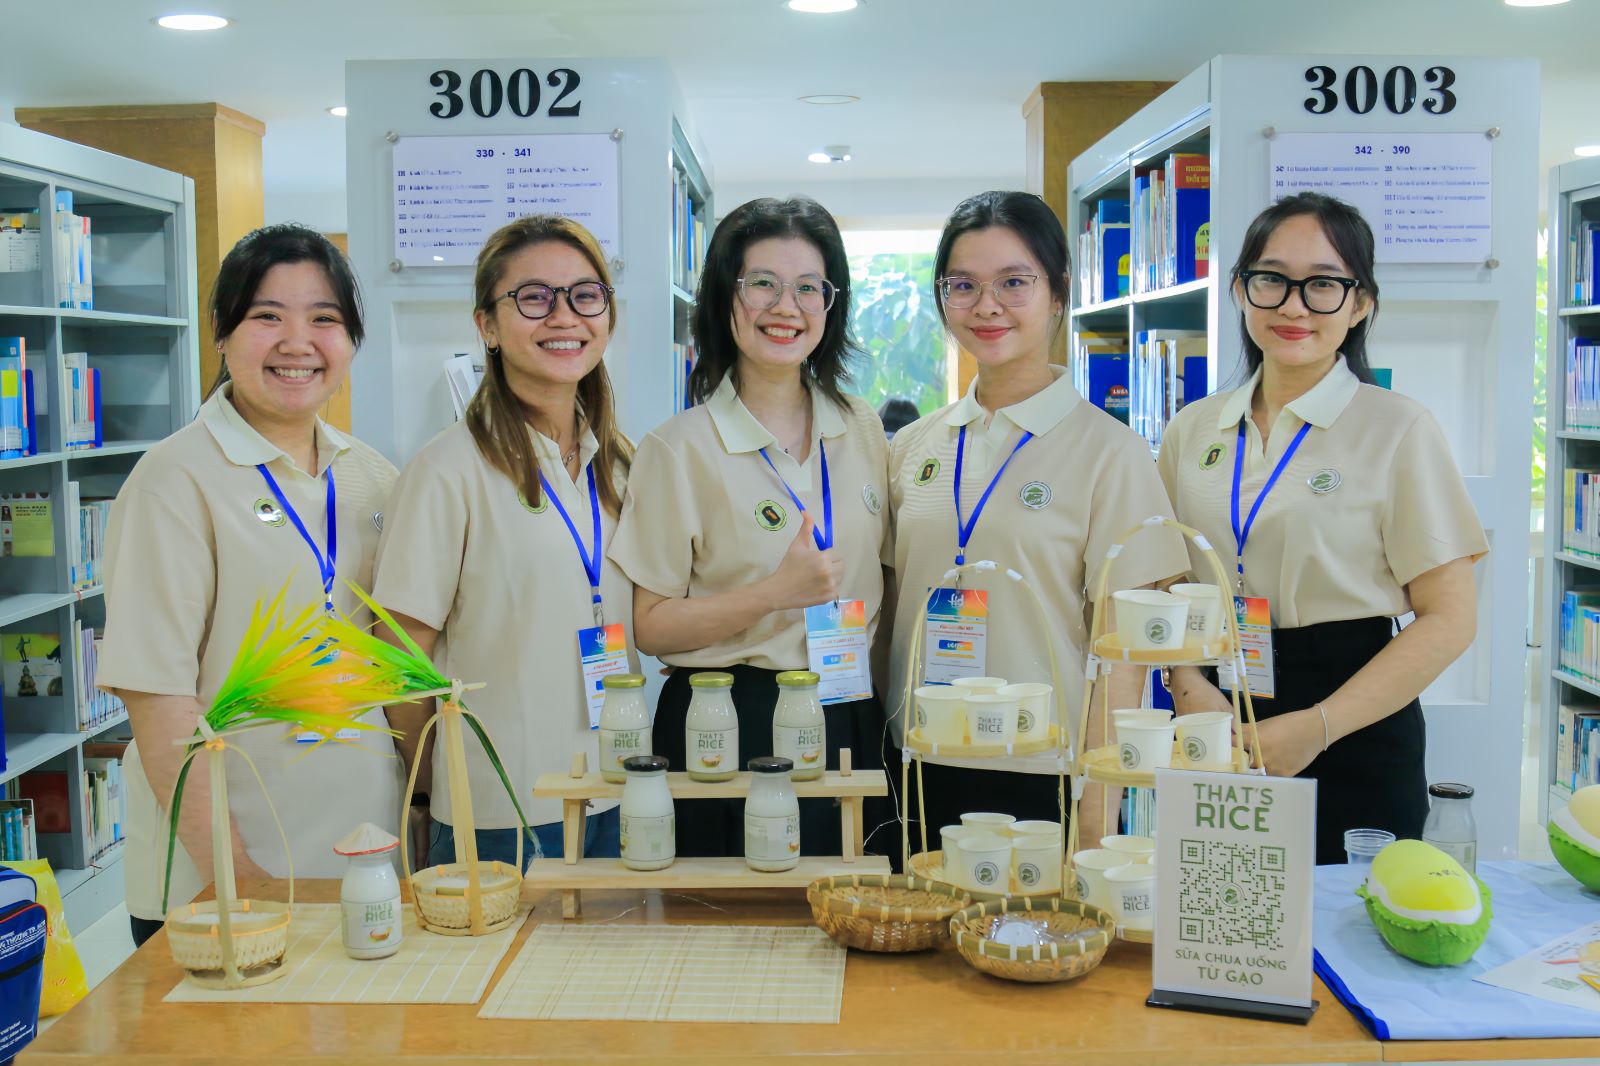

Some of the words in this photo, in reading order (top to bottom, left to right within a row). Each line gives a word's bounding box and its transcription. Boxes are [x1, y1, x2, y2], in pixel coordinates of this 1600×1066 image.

[430, 68, 581, 118] 3002
[1303, 65, 1457, 114] 3003
[476, 149, 494, 158] 330
[514, 148, 531, 157] 341
[1354, 145, 1372, 155] 342
[1392, 145, 1410, 155] 390
[978, 723, 1004, 733] RICE
[614, 739, 641, 749] RICE
[698, 739, 726, 750] RICE
[798, 735, 823, 745] RICE
[1192, 783, 1274, 806] THAT'S
[1196, 802, 1271, 832] RICE
[1123, 902, 1151, 912] RICE
[365, 910, 394, 923] RICE
[1205, 952, 1242, 966] CHUA
[1197, 964, 1221, 981] TỪ
[1225, 970, 1264, 987] GẠO
